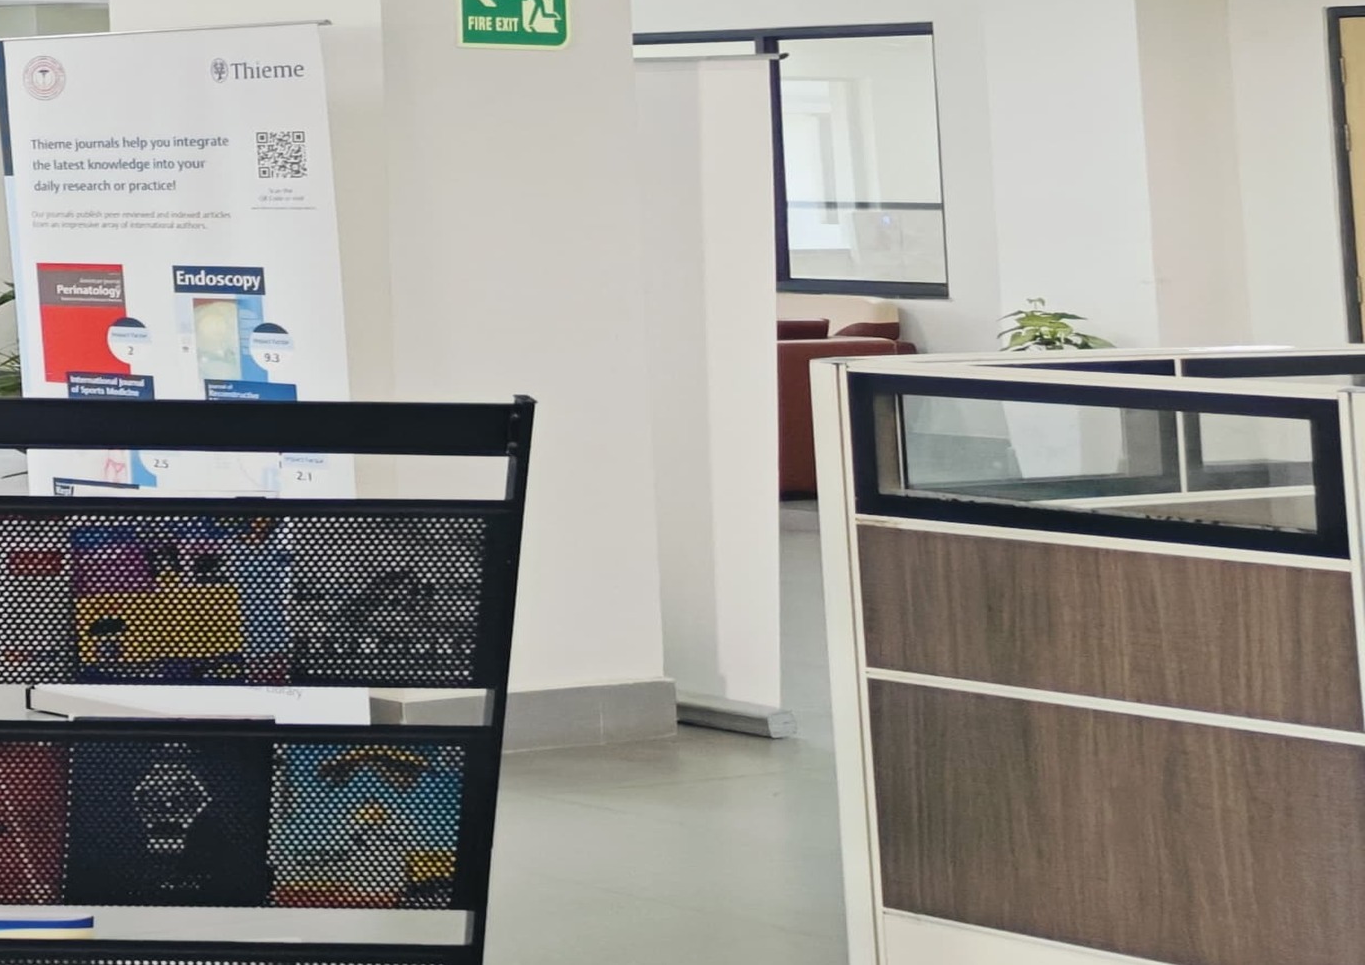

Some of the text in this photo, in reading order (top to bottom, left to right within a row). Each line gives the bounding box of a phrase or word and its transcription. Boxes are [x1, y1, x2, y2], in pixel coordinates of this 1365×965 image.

[468, 15, 519, 32] FIRE EXIT
[231, 62, 305, 80] Thieme
[31, 136, 229, 152] Thieme journals help you integrate
[33, 157, 206, 173] the latest knowledge into your
[34, 179, 176, 194] daily research or practice!
[175, 269, 261, 291] Endoscopy
[56, 284, 122, 298] Perinatology
[128, 346, 134, 356] 2
[263, 353, 280, 363] 9.3
[70, 376, 145, 387] International Journal
[70, 385, 140, 397] of Sports Medicine
[208, 390, 260, 400] Reconstructive
[153, 459, 169, 469] 2.5
[296, 471, 313, 482] 2.1
